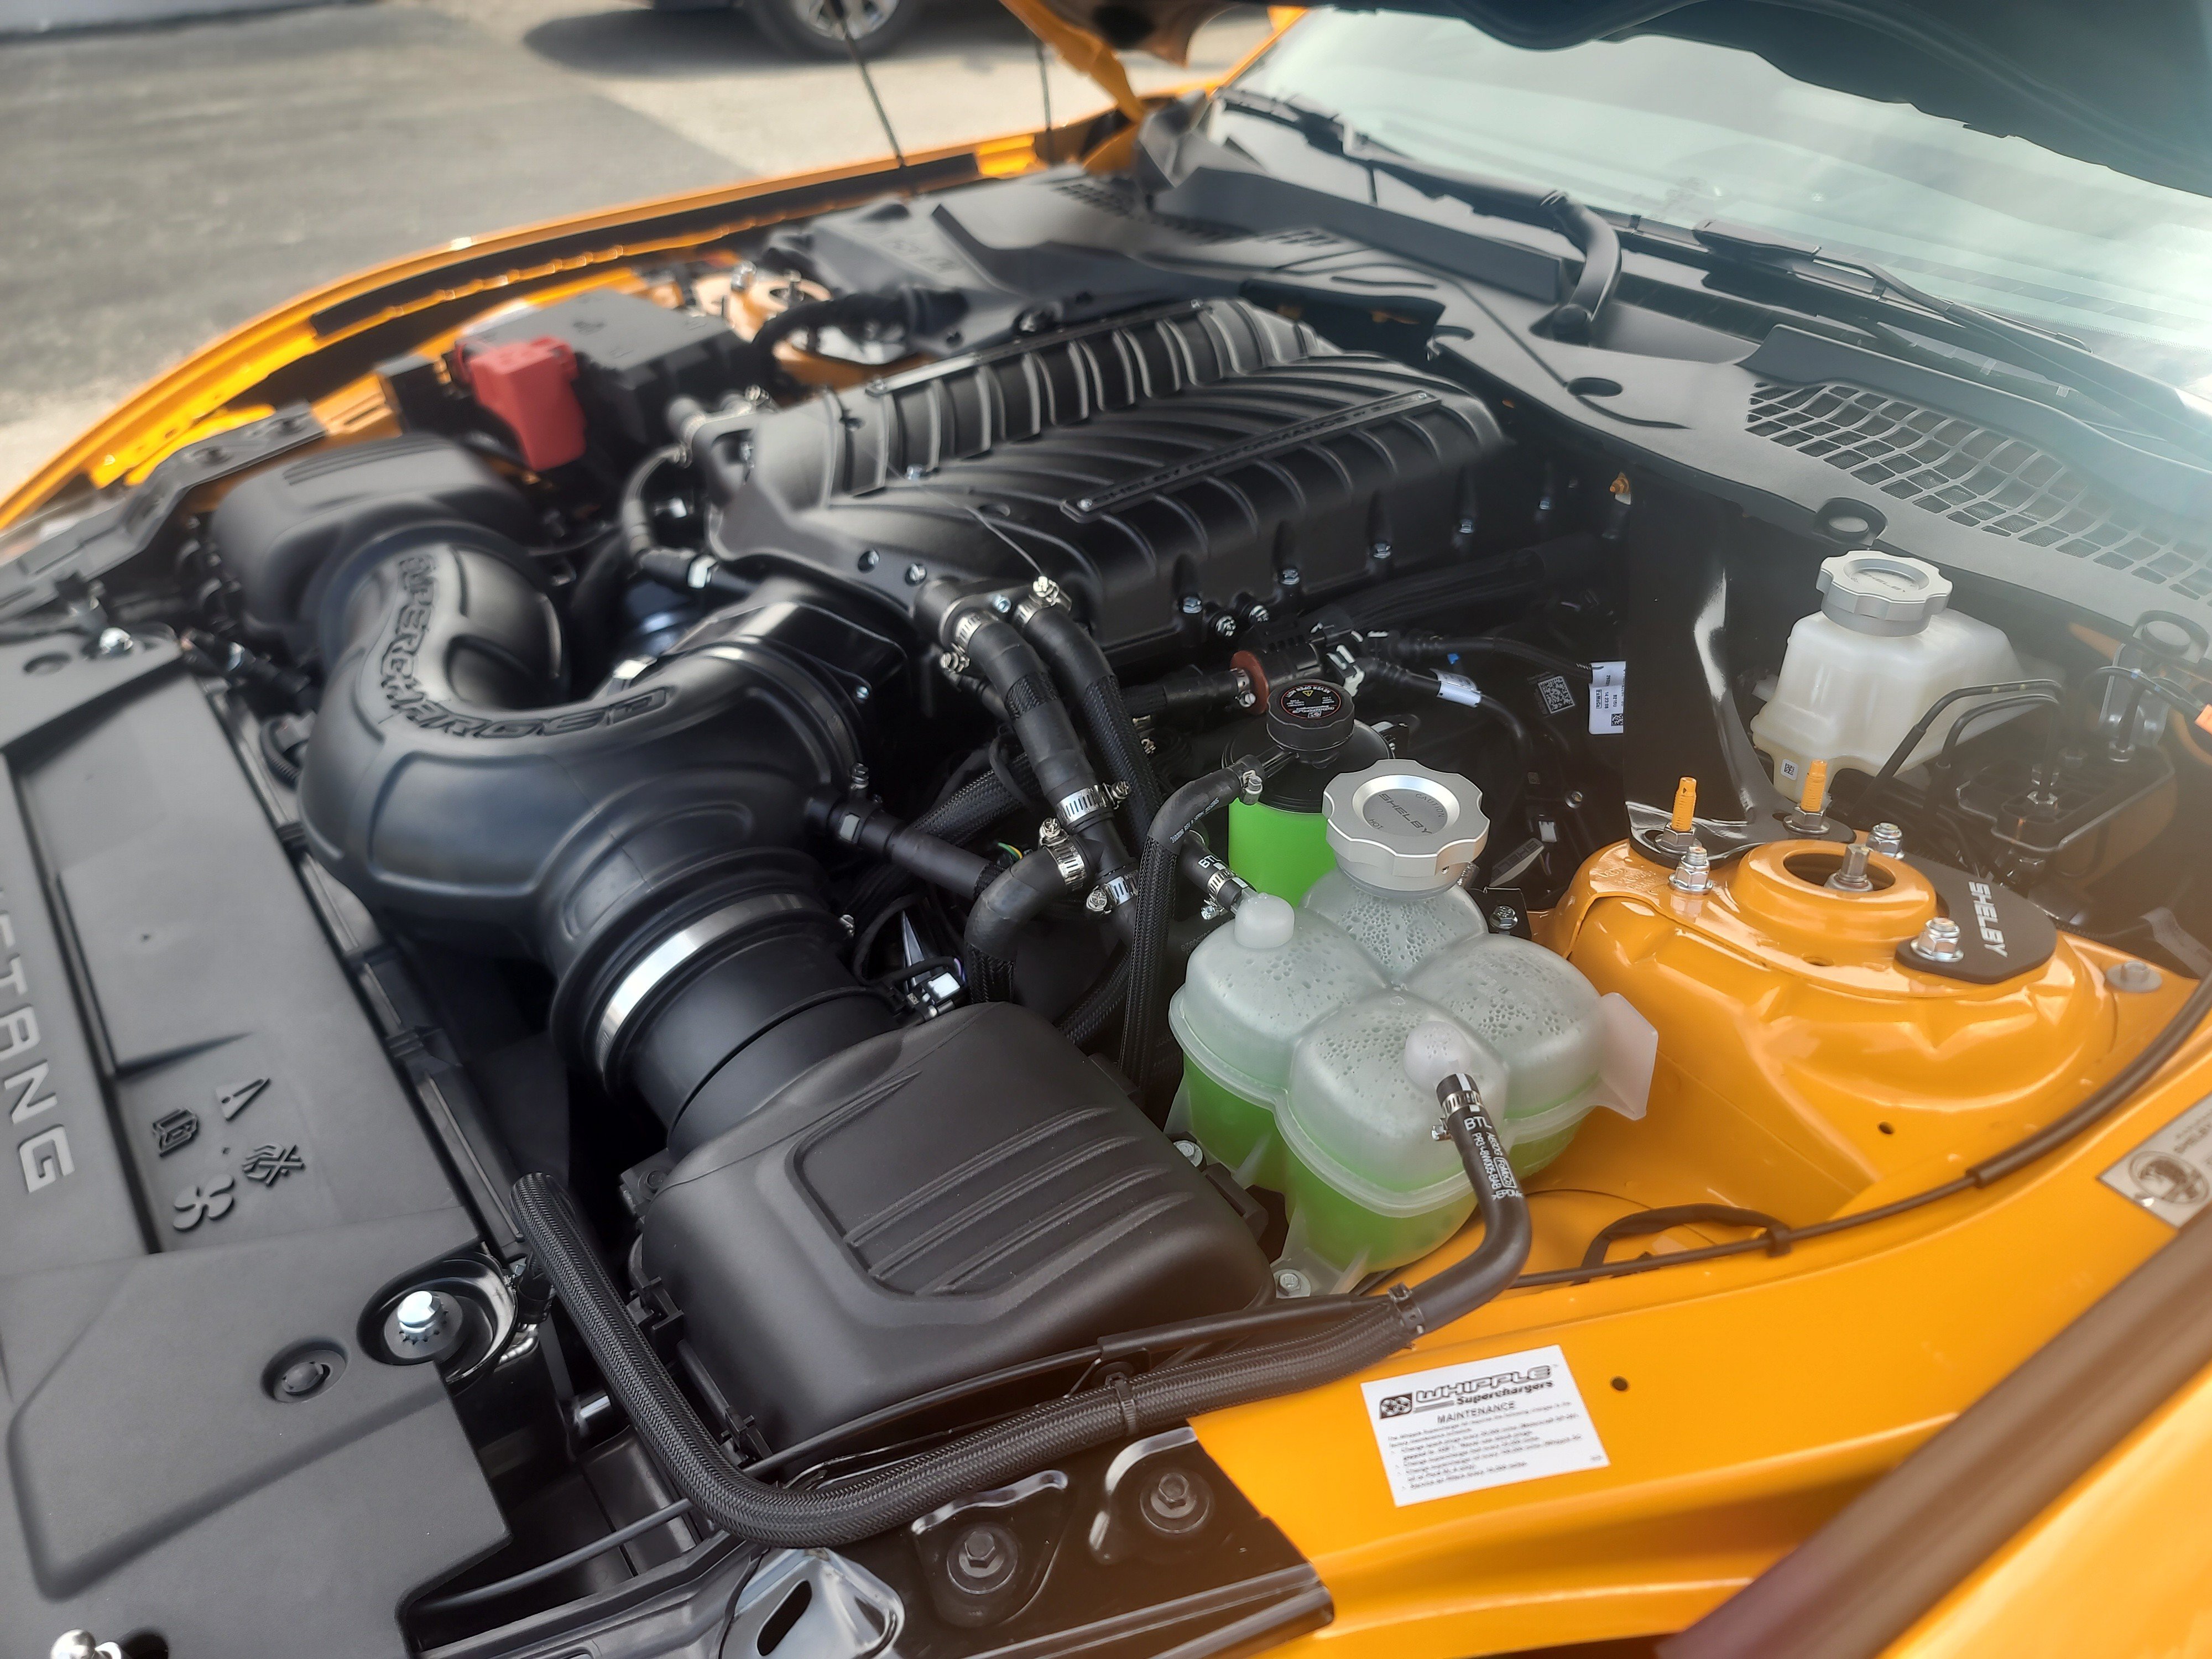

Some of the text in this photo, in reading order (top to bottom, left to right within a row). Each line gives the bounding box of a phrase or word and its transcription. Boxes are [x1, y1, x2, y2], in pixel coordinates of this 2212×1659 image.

[1379, 793, 1433, 834] SHELBY
[1415, 793, 1445, 817] CAUTION
[1369, 818, 1384, 830] HOT
[1198, 855, 1221, 868] BTL
[1968, 880, 2008, 958] SHELBY
[1464, 1116, 1493, 1131] BTL
[1416, 1365, 1552, 1403] WHIPPLE
[1456, 1381, 1554, 1405] Superchargers
[1437, 1401, 1516, 1423] MAINTENANCE
